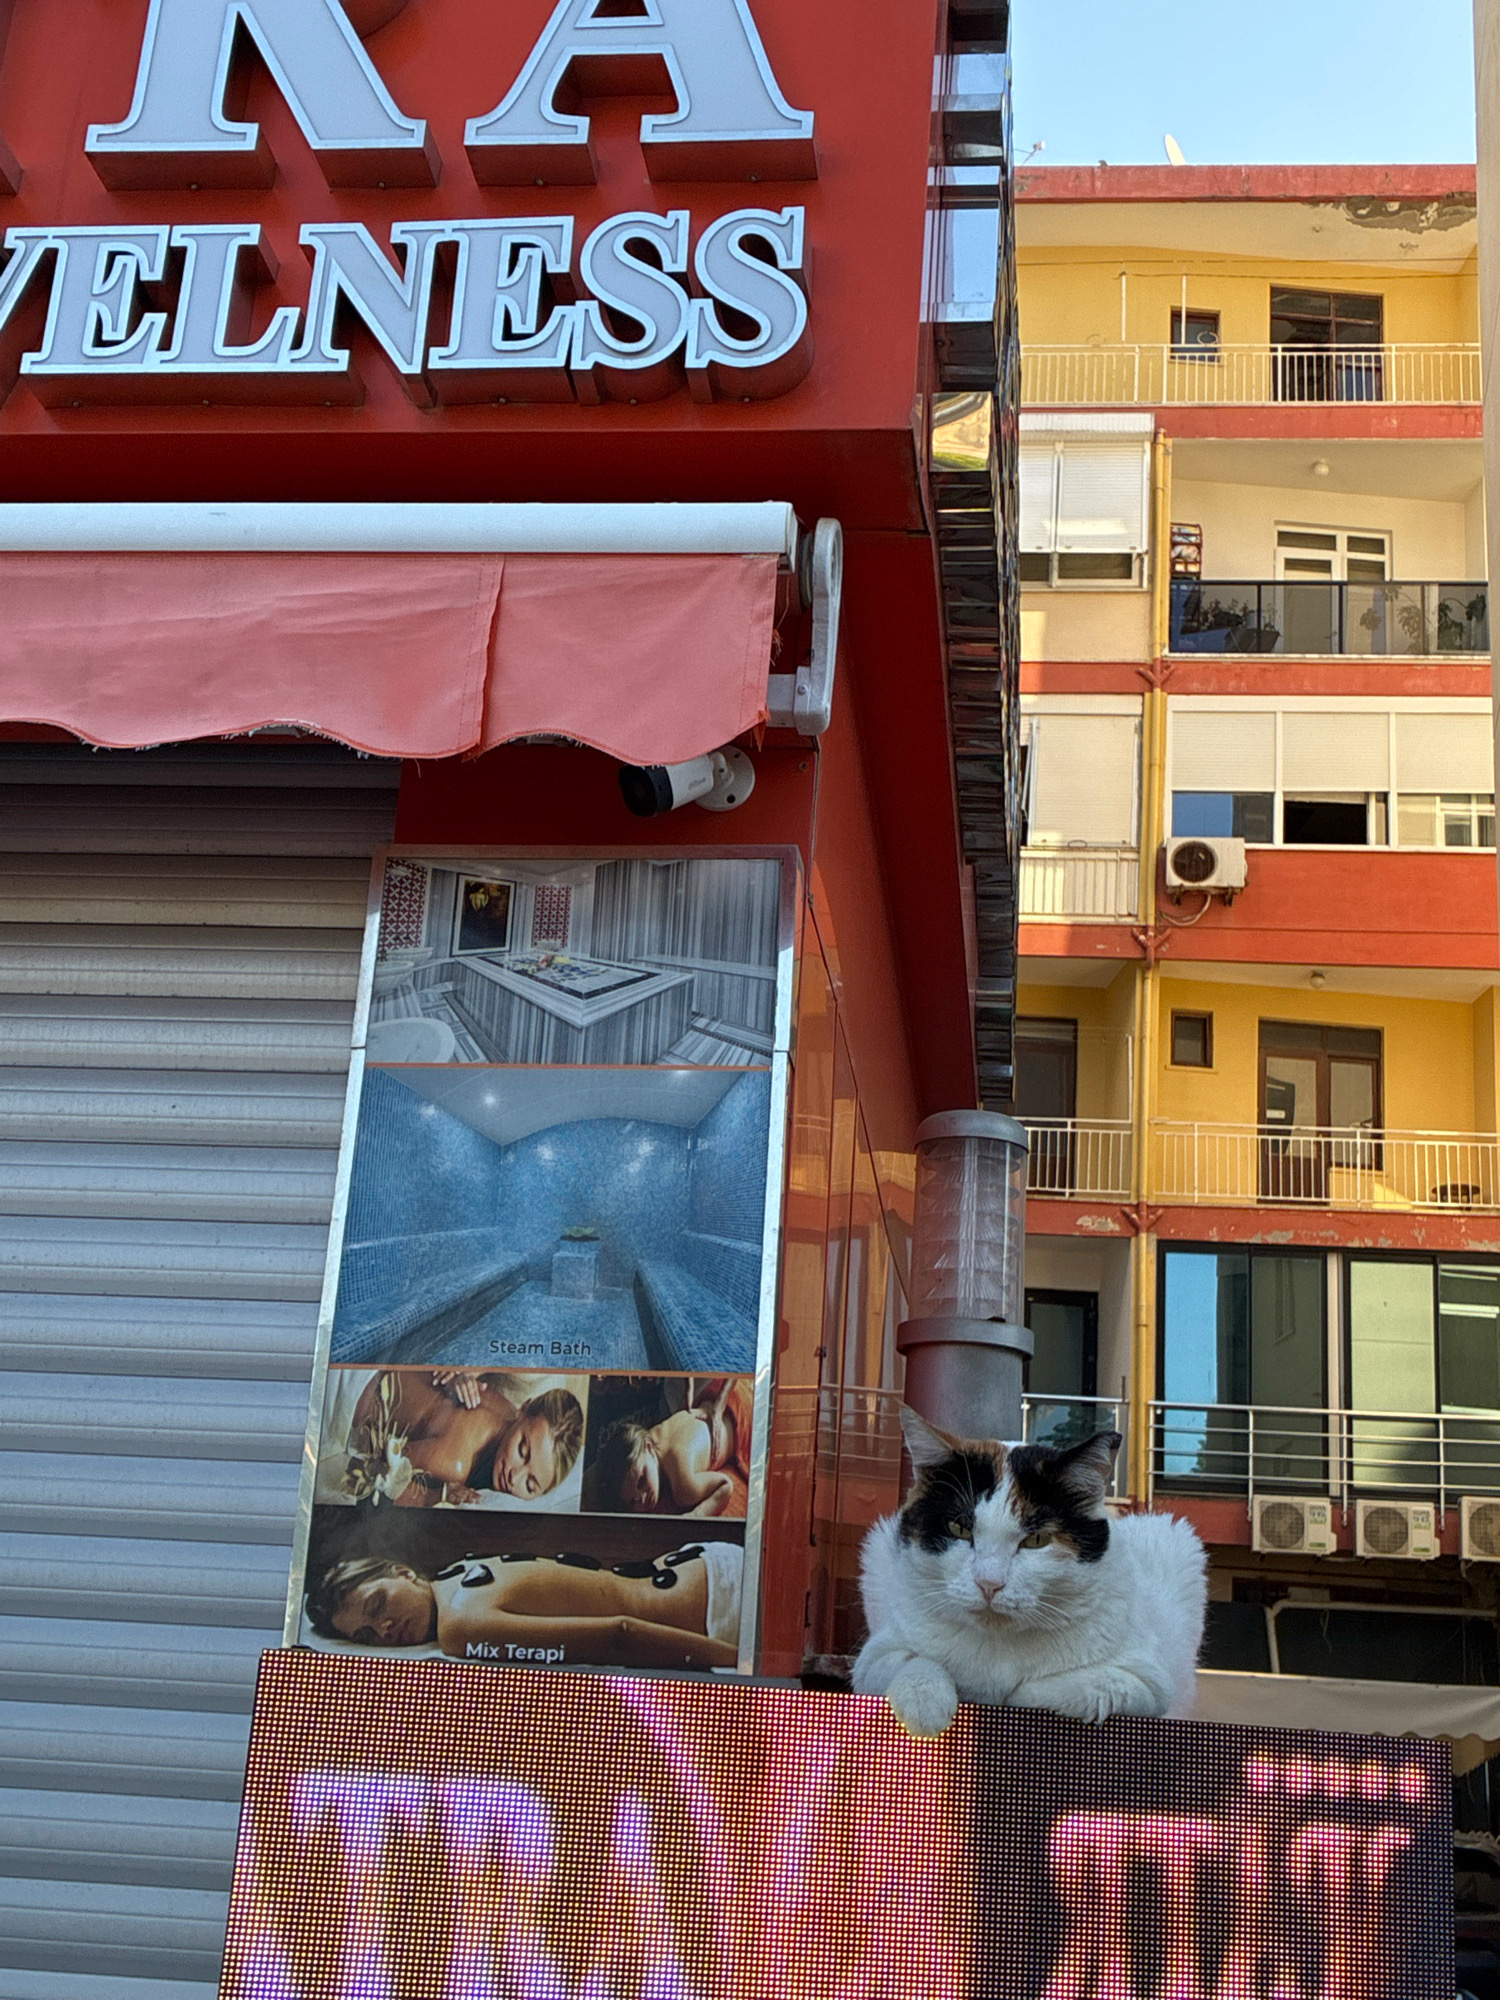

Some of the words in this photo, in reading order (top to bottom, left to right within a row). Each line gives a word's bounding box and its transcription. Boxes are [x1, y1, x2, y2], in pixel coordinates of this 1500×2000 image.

[0, 206, 807, 374] ELNESS
[489, 1340, 545, 1355] Steam
[550, 1341, 592, 1356] Bath
[466, 1641, 500, 1658] Mix
[504, 1643, 565, 1664] Terapi
